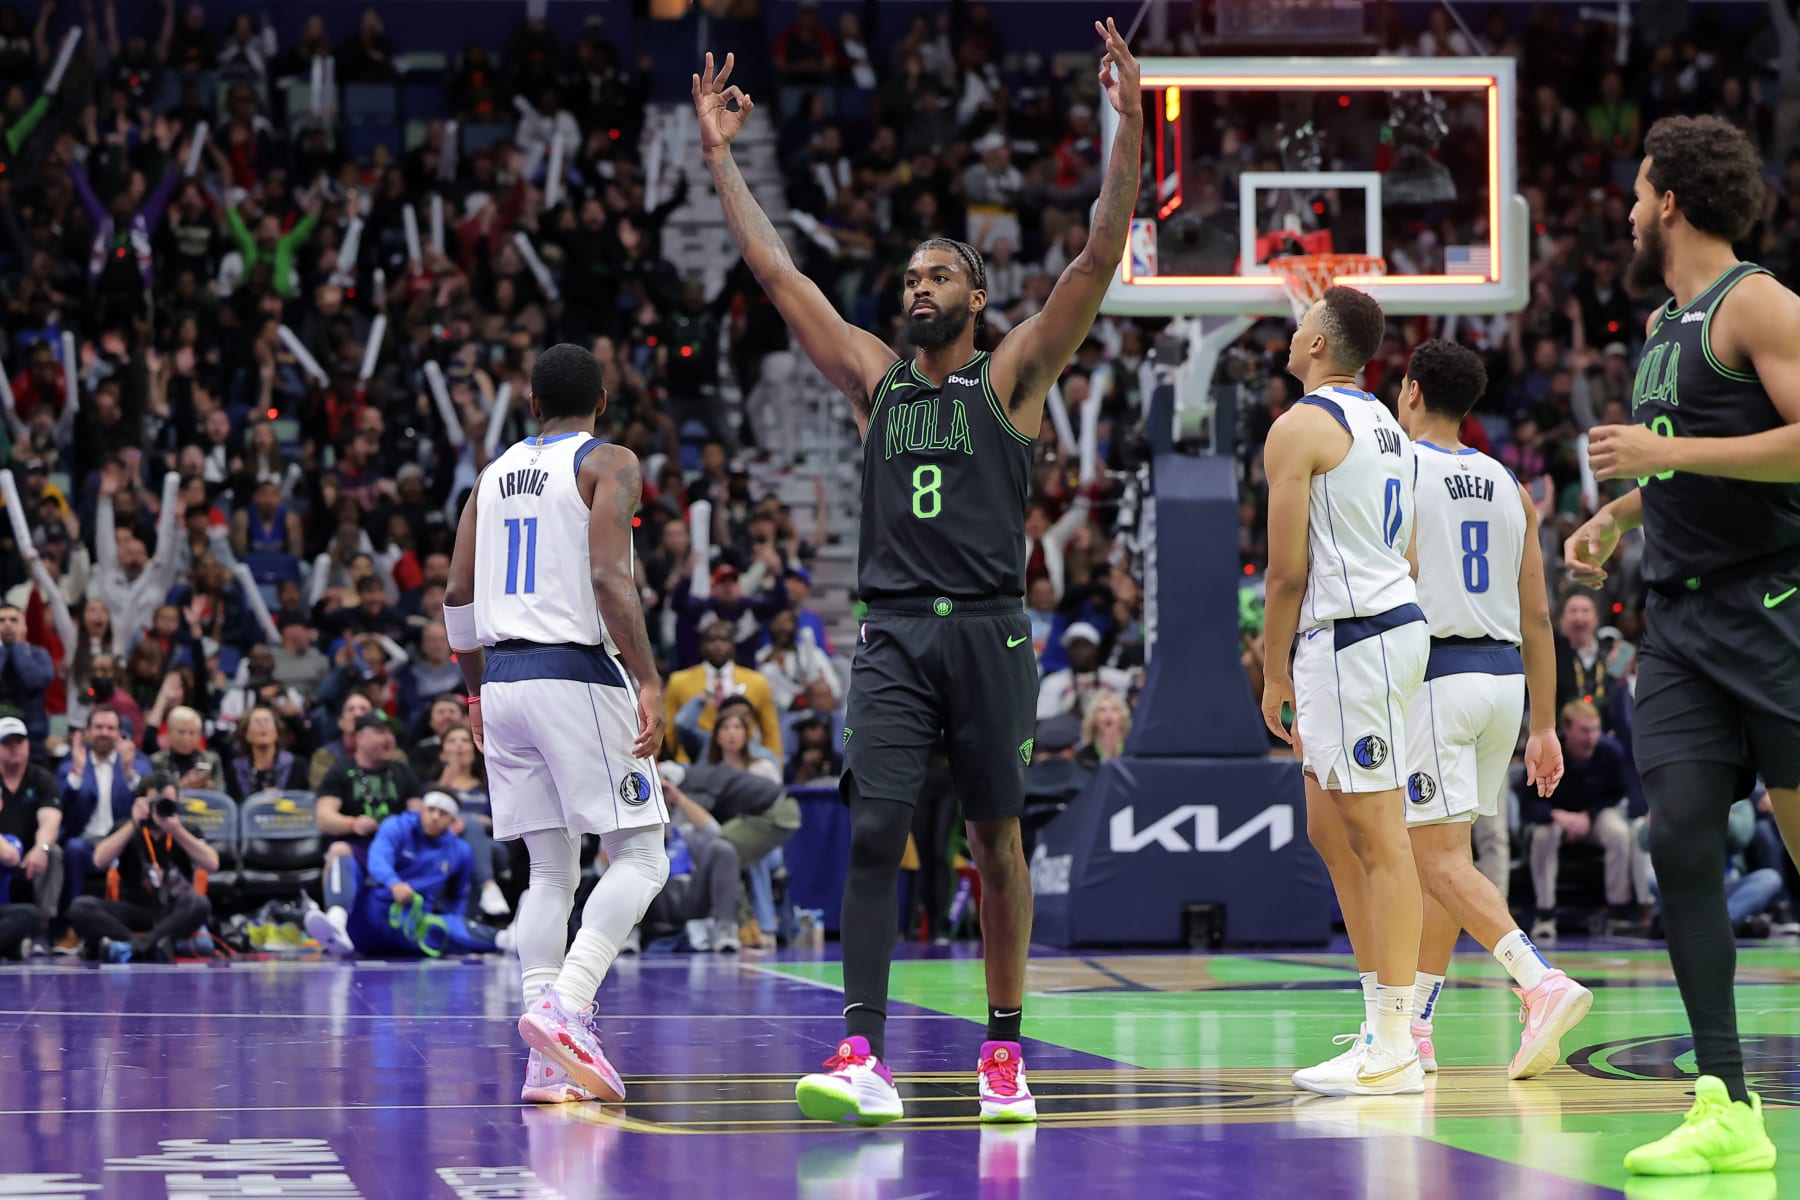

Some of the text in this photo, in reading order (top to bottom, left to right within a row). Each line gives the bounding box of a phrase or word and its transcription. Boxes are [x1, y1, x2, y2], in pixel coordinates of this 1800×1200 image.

[948, 375, 980, 387] ibotta
[885, 398, 974, 461] NOLA
[1374, 428, 1402, 458] EXUM
[499, 468, 549, 500] IRVING
[912, 464, 942, 519] 8
[1444, 474, 1494, 502] GREEN
[1383, 478, 1403, 549] 0
[504, 517, 538, 595] 11
[1461, 520, 1490, 594] 8
[1109, 804, 1294, 852] KIA
